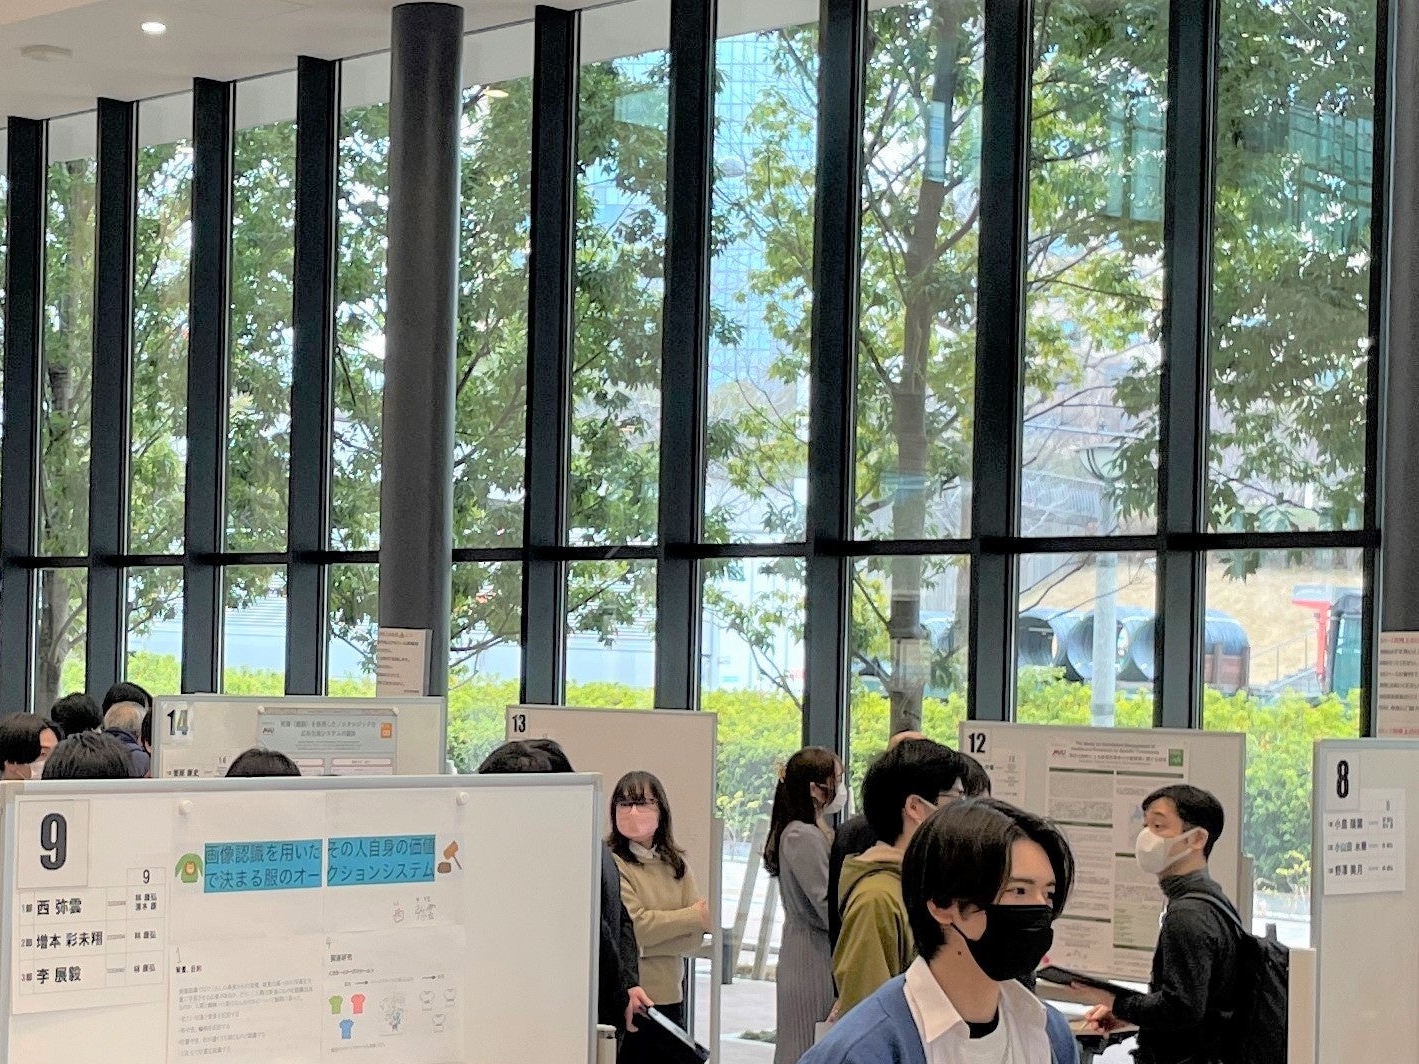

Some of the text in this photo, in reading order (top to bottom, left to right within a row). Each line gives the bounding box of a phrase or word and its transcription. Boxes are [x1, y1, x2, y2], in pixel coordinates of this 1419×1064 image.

[167, 709, 190, 736] 14
[512, 714, 526, 733] 13
[968, 732, 987, 754] 12
[1336, 760, 1349, 799] 8
[39, 813, 68, 870] 9
[142, 869, 150, 884] 9
[37, 900, 50, 915] 西
[37, 969, 49, 984] 李
